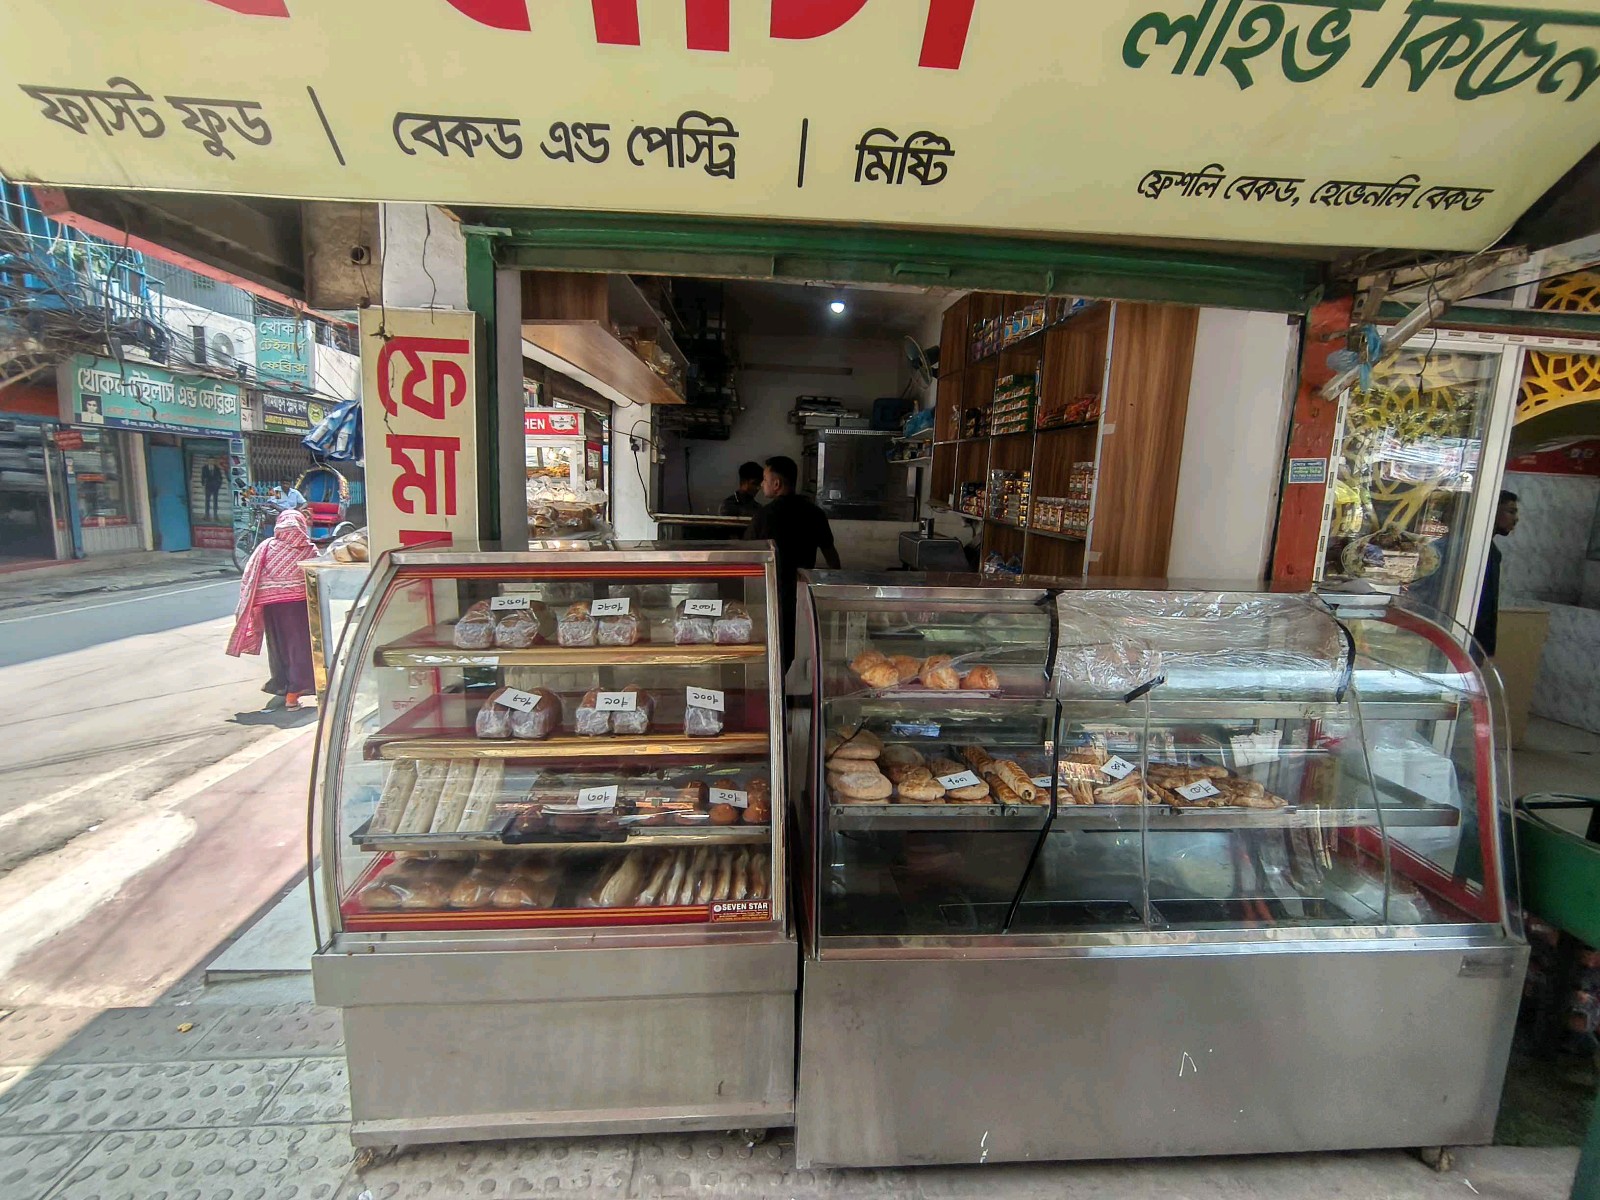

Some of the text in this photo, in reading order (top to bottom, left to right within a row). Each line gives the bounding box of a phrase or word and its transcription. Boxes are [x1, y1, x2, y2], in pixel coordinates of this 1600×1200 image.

[19, 78, 166, 139] ফাস্ট
[164, 95, 272, 160] ফুড
[393, 112, 523, 160] বেকড
[626, 110, 740, 180] পেস্ট্রি
[854, 127, 956, 186] মিষ্টি
[1137, 162, 1495, 212] ফ্রেশলি বেকড, হেভেনলি বেকড
[78, 368, 126, 397] খোকন
[128, 369, 175, 403] টেইলার্স
[200, 384, 237, 416] ফেব্রিক্স
[722, 902, 768, 911] SEVEN STAR
